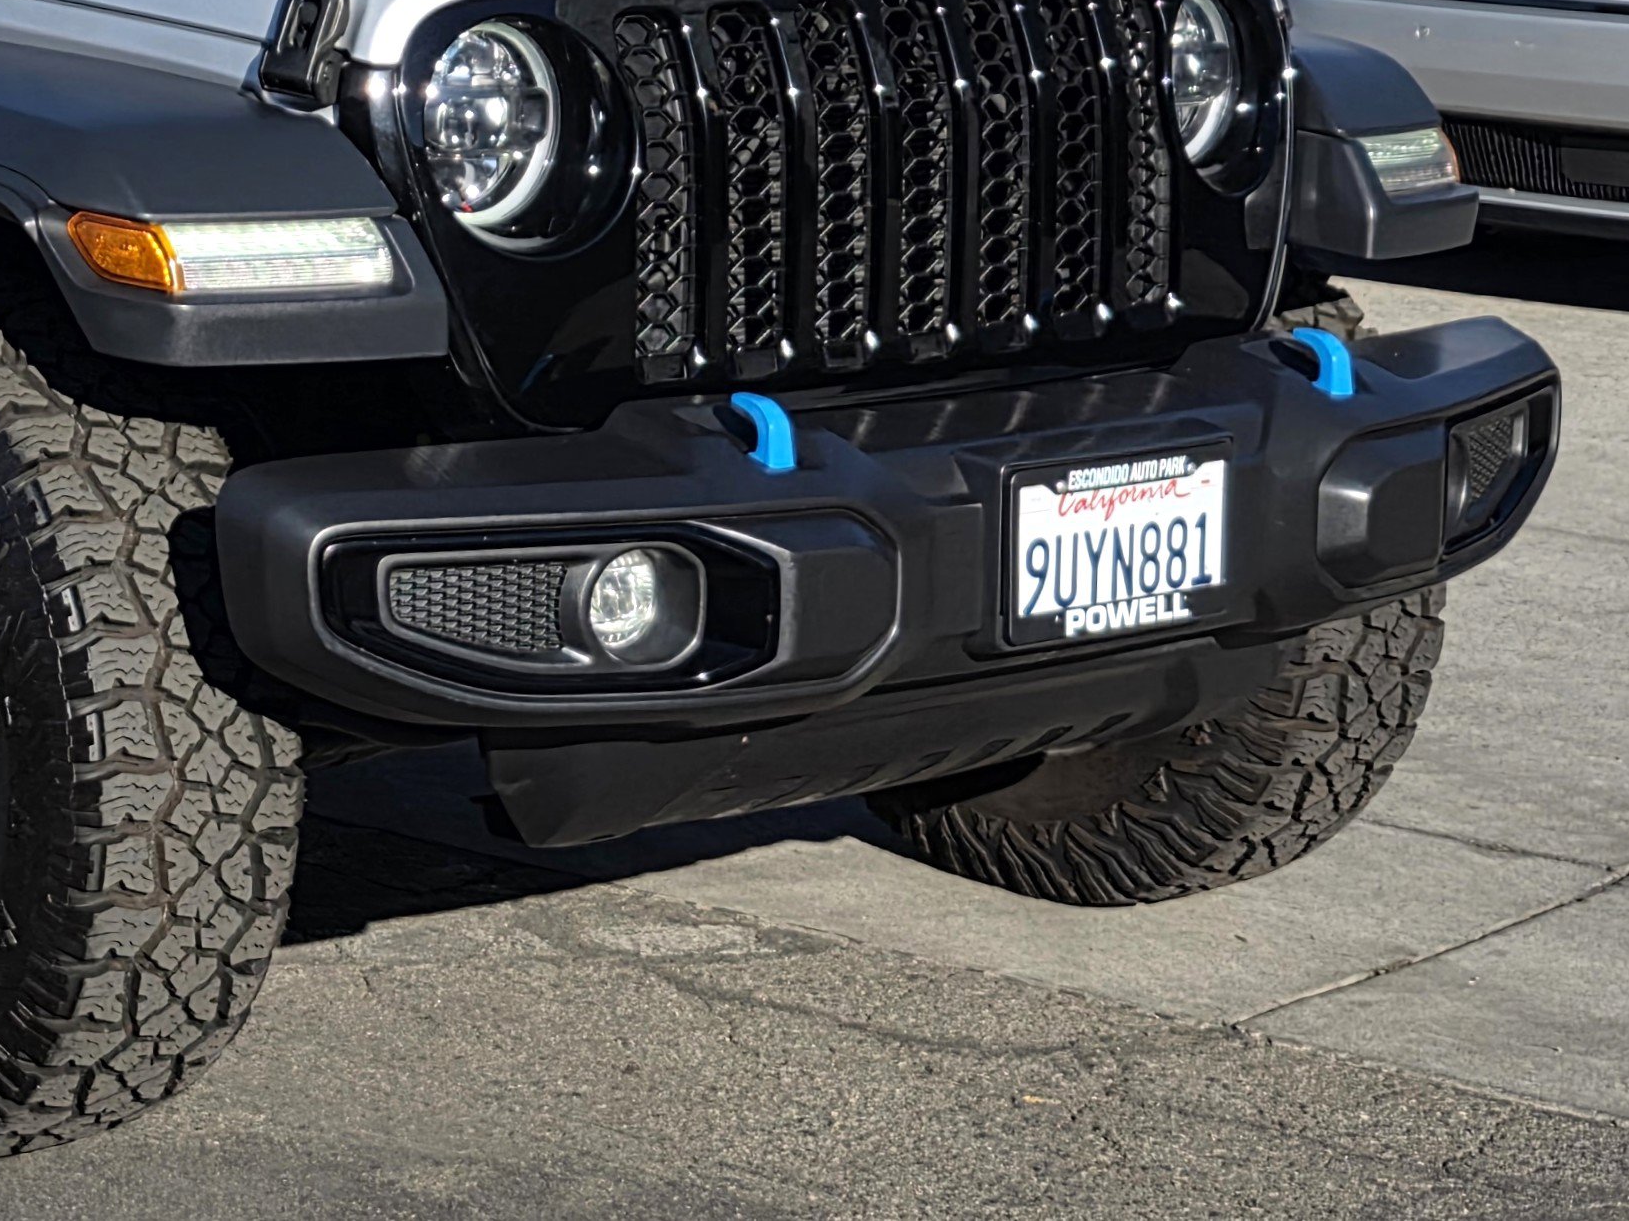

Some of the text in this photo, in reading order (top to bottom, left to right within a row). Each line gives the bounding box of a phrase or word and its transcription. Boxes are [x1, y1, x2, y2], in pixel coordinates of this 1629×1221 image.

[1068, 455, 1187, 490] ESCONDIDO AUTO PARK
[1059, 479, 1190, 521] California
[1025, 511, 1213, 617] 9UYN881
[1065, 592, 1190, 637] POWELL
